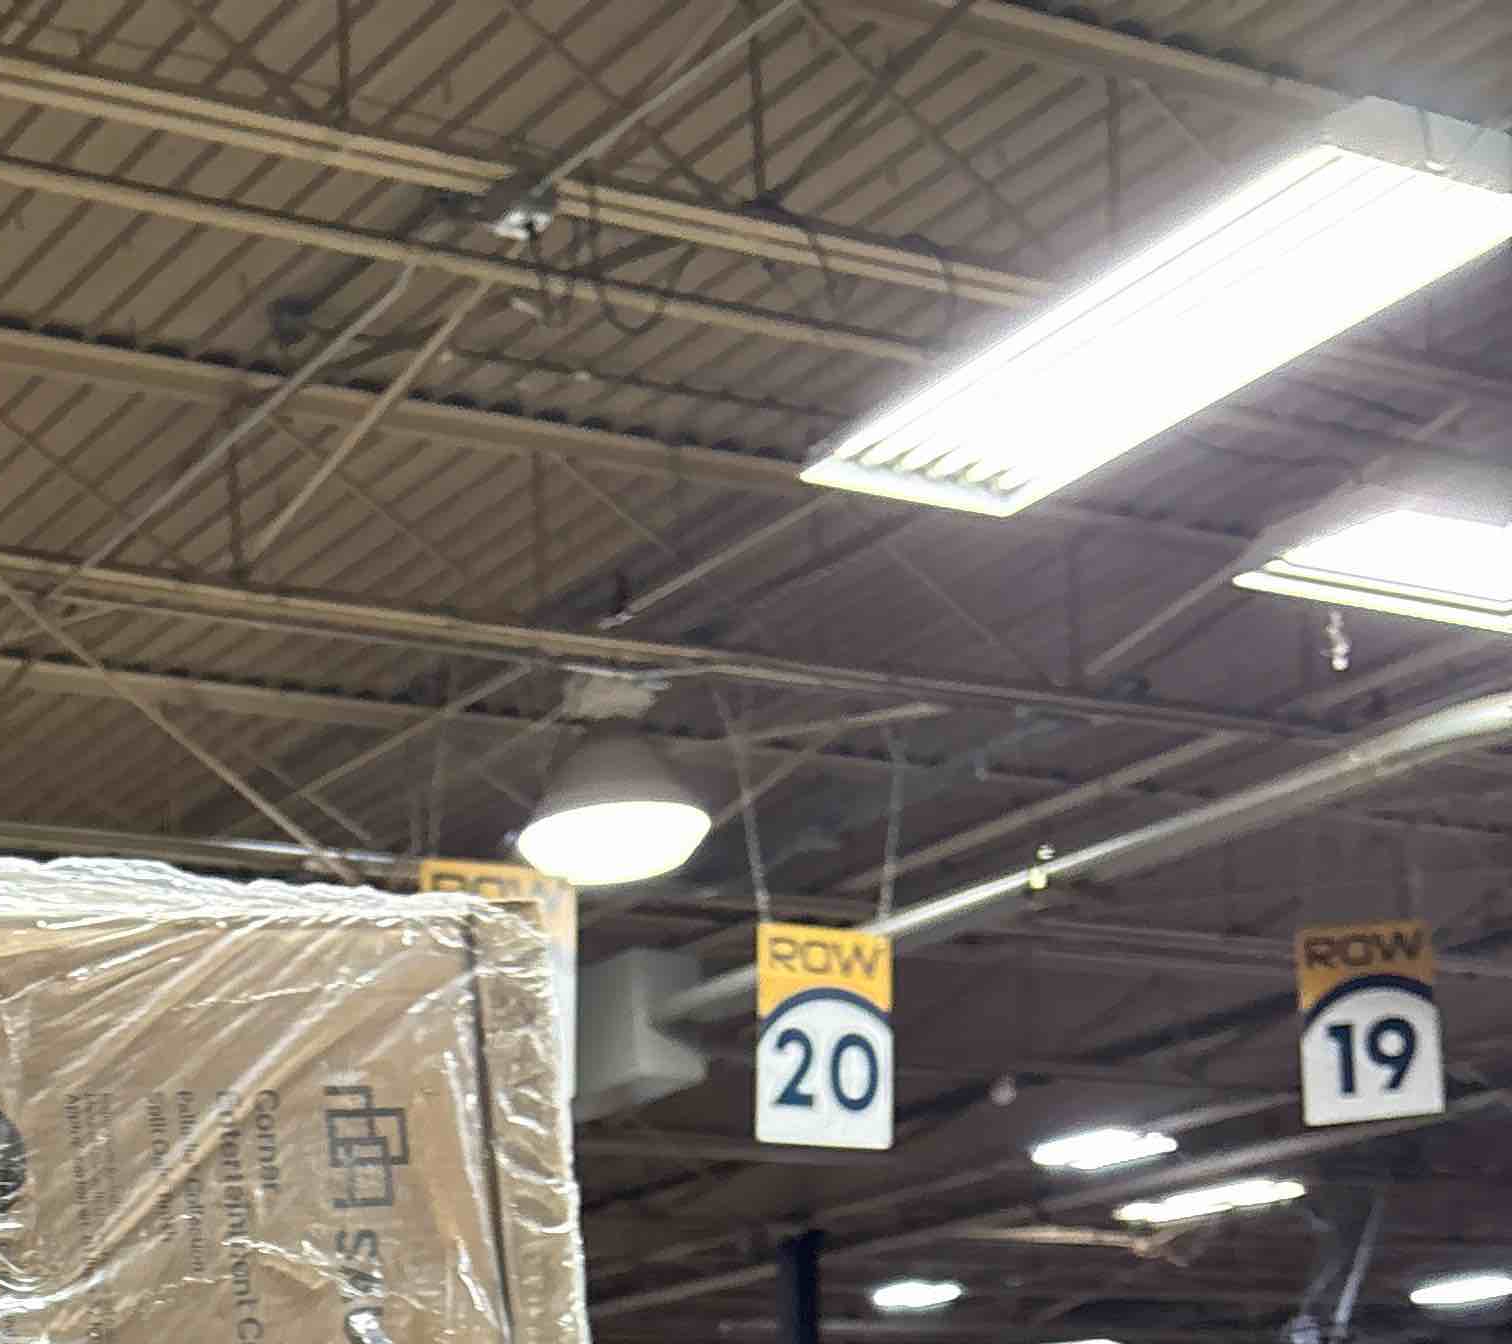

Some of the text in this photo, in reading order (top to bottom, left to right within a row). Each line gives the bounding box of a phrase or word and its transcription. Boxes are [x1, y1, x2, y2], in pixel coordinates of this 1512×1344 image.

[767, 935, 885, 979] ROW
[1303, 926, 1427, 971] ROW
[772, 1027, 879, 1112] 20
[1325, 1018, 1418, 1096] 19
